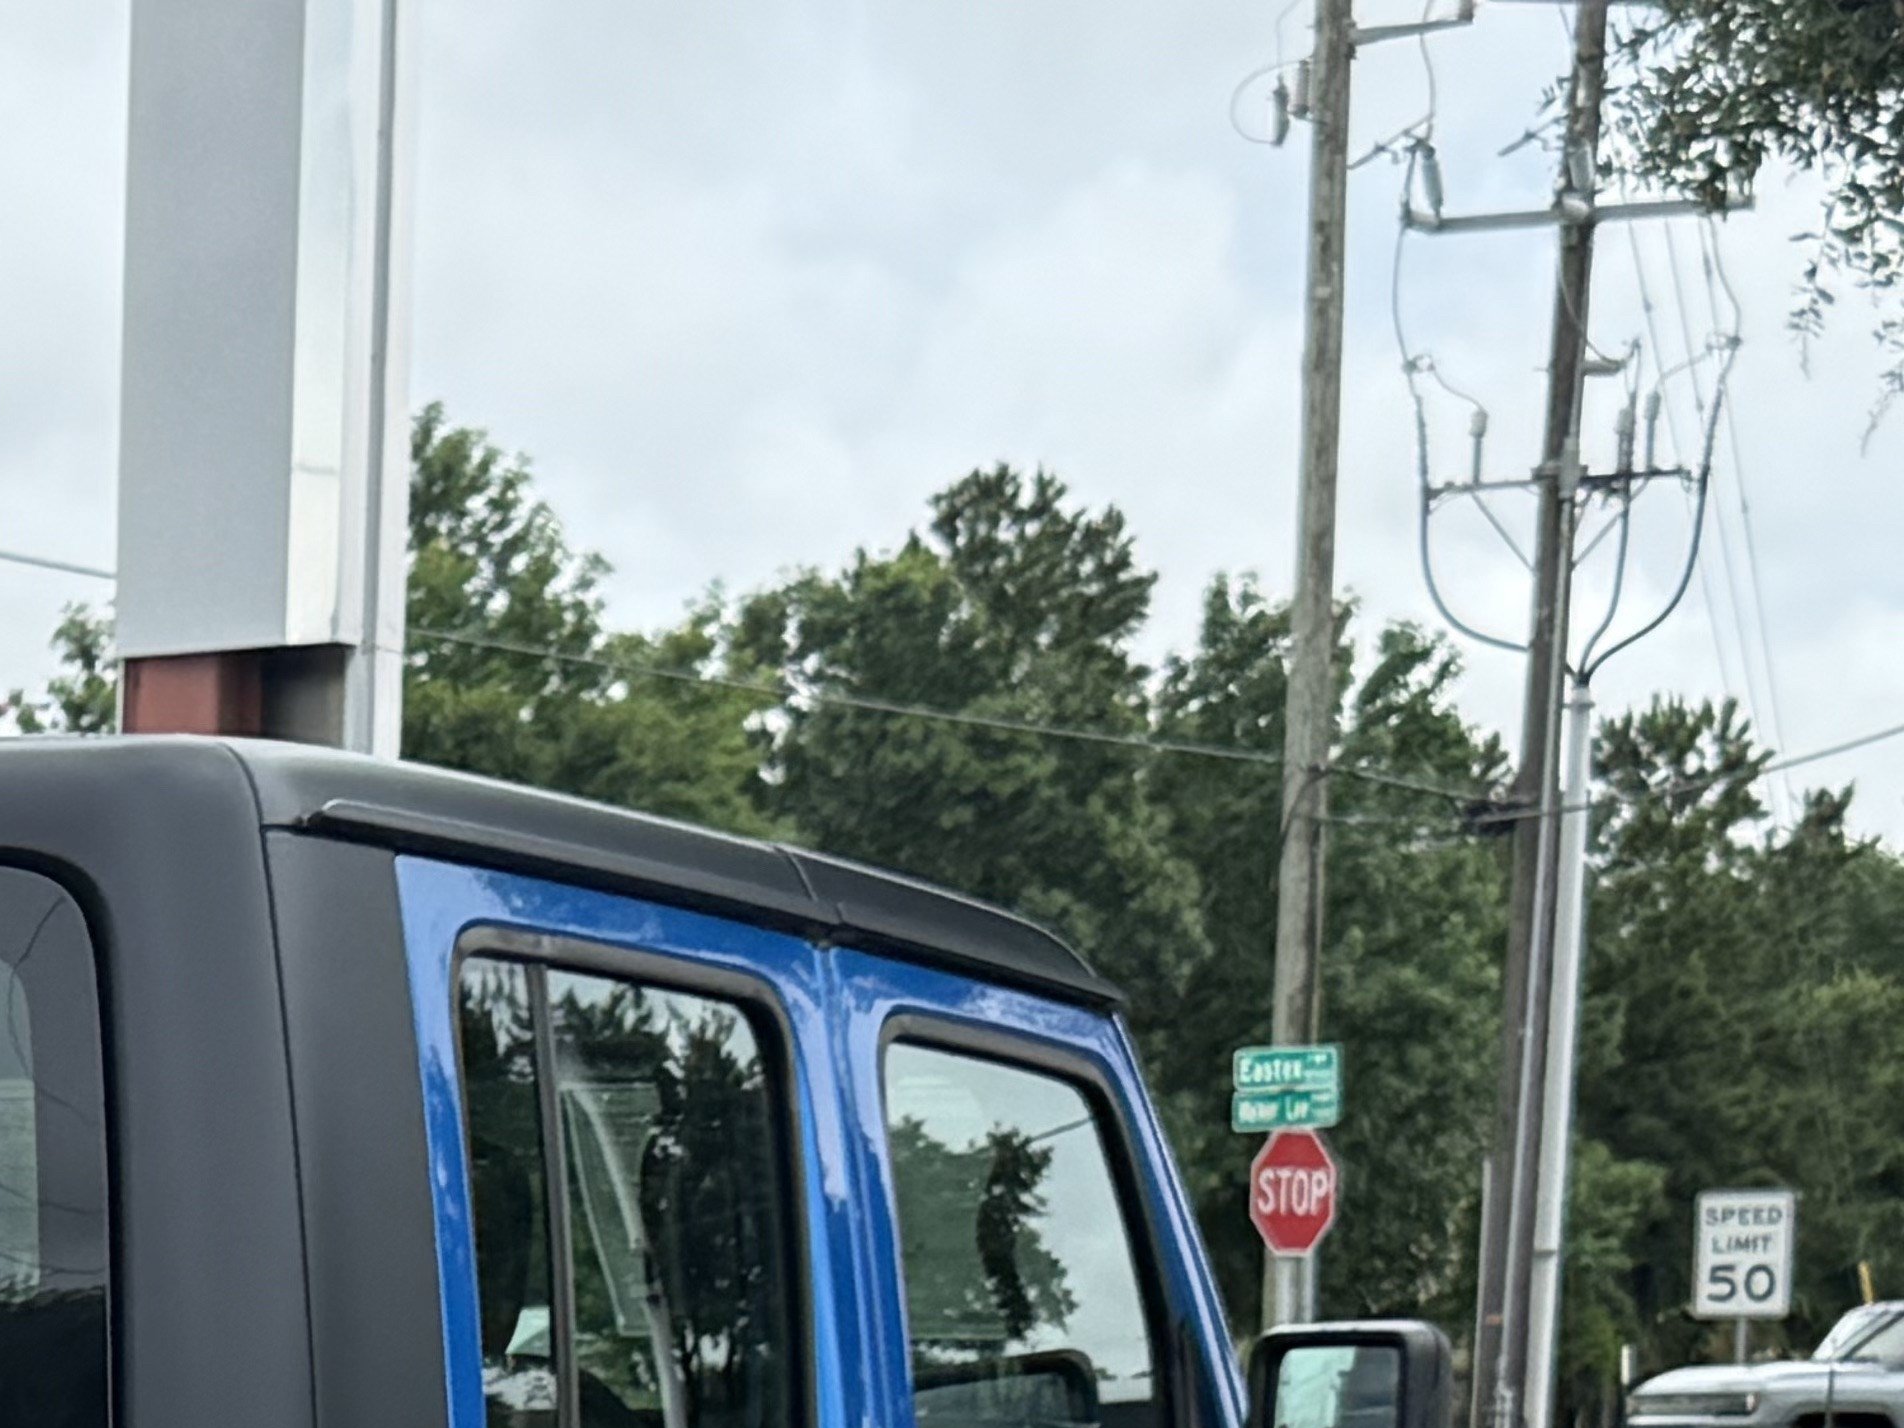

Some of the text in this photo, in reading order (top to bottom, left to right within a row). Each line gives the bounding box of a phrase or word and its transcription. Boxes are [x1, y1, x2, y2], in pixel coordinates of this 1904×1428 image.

[1258, 1167, 1328, 1216] STOP
[1705, 1207, 1783, 1227] SPEED
[1711, 1235, 1772, 1254] LIMIT
[1707, 1264, 1776, 1303] 50
